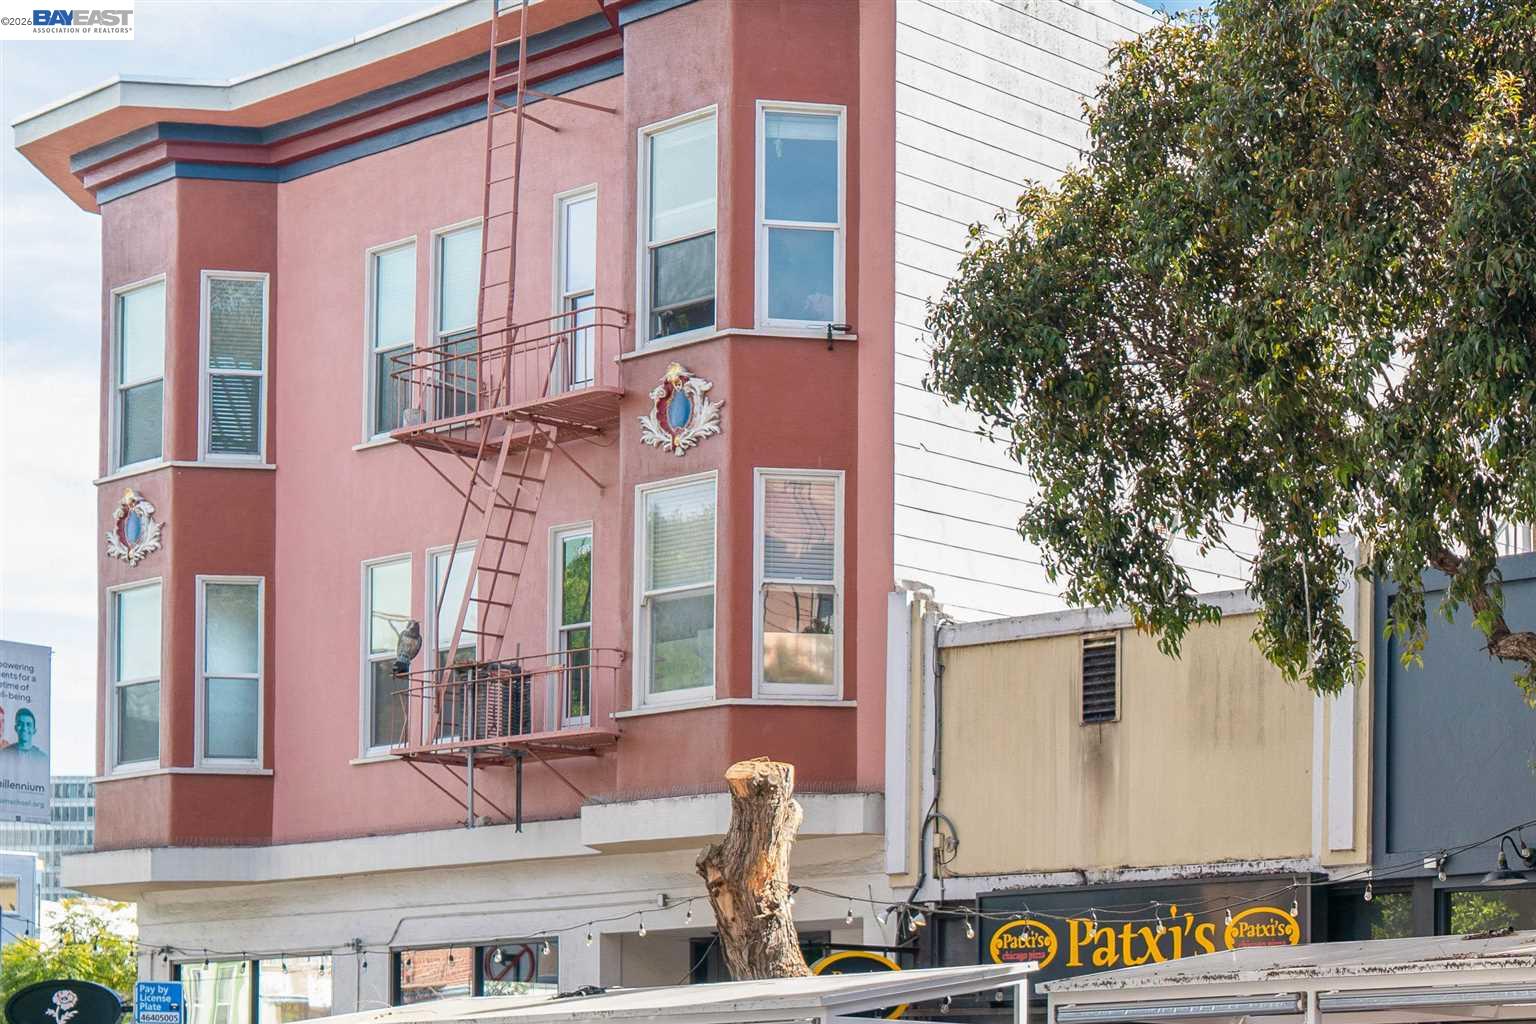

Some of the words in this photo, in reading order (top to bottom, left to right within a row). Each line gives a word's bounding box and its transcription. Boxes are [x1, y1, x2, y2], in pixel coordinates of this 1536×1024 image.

[0, 779, 45, 792] illennium
[1239, 918, 1285, 938] Patxi's
[1066, 904, 1216, 967] Patxi's
[140, 984, 155, 995] Pay
[158, 984, 168, 995] by
[140, 993, 171, 1003] License
[140, 1002, 161, 1010] Plate
